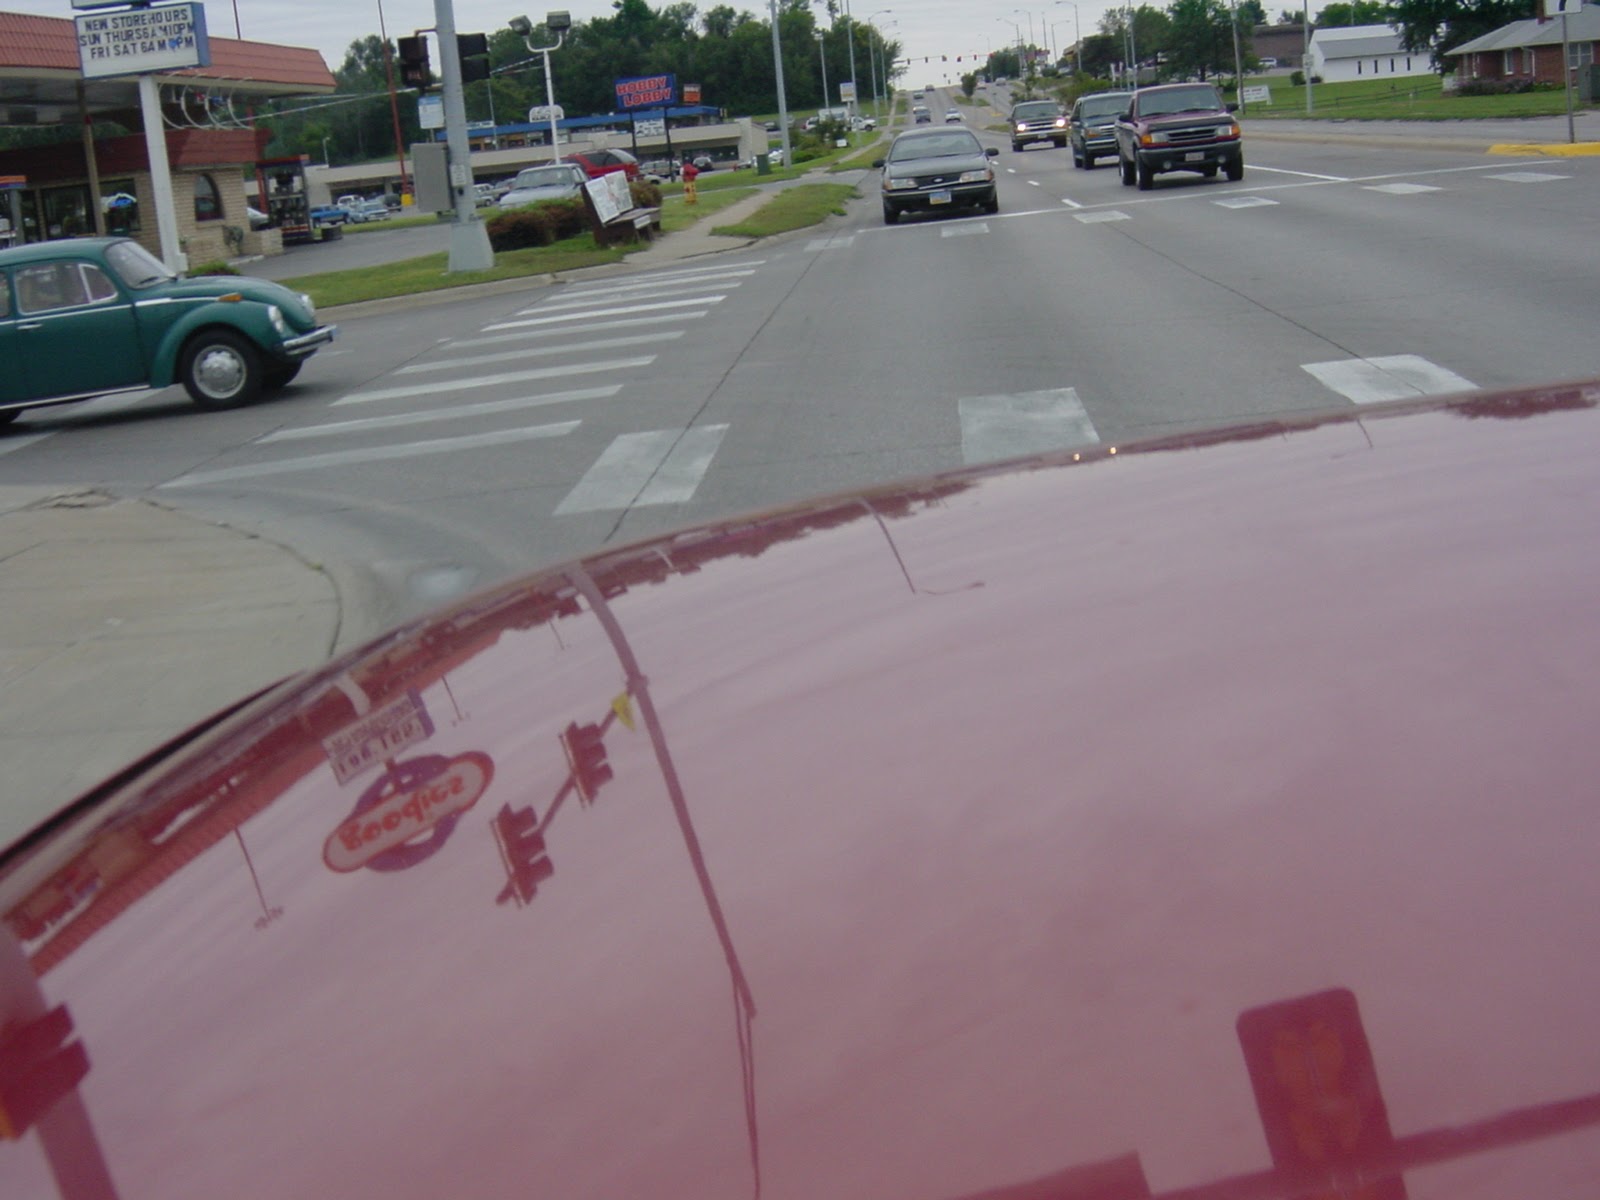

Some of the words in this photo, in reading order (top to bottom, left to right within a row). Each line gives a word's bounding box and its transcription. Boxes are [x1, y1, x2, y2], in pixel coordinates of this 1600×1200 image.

[85, 19, 108, 32] NEW
[80, 33, 101, 47] SUN
[90, 47, 110, 59] FRI
[114, 43, 137, 56] SAT
[616, 76, 667, 96] HOBBY
[623, 87, 672, 107] LOBBY
